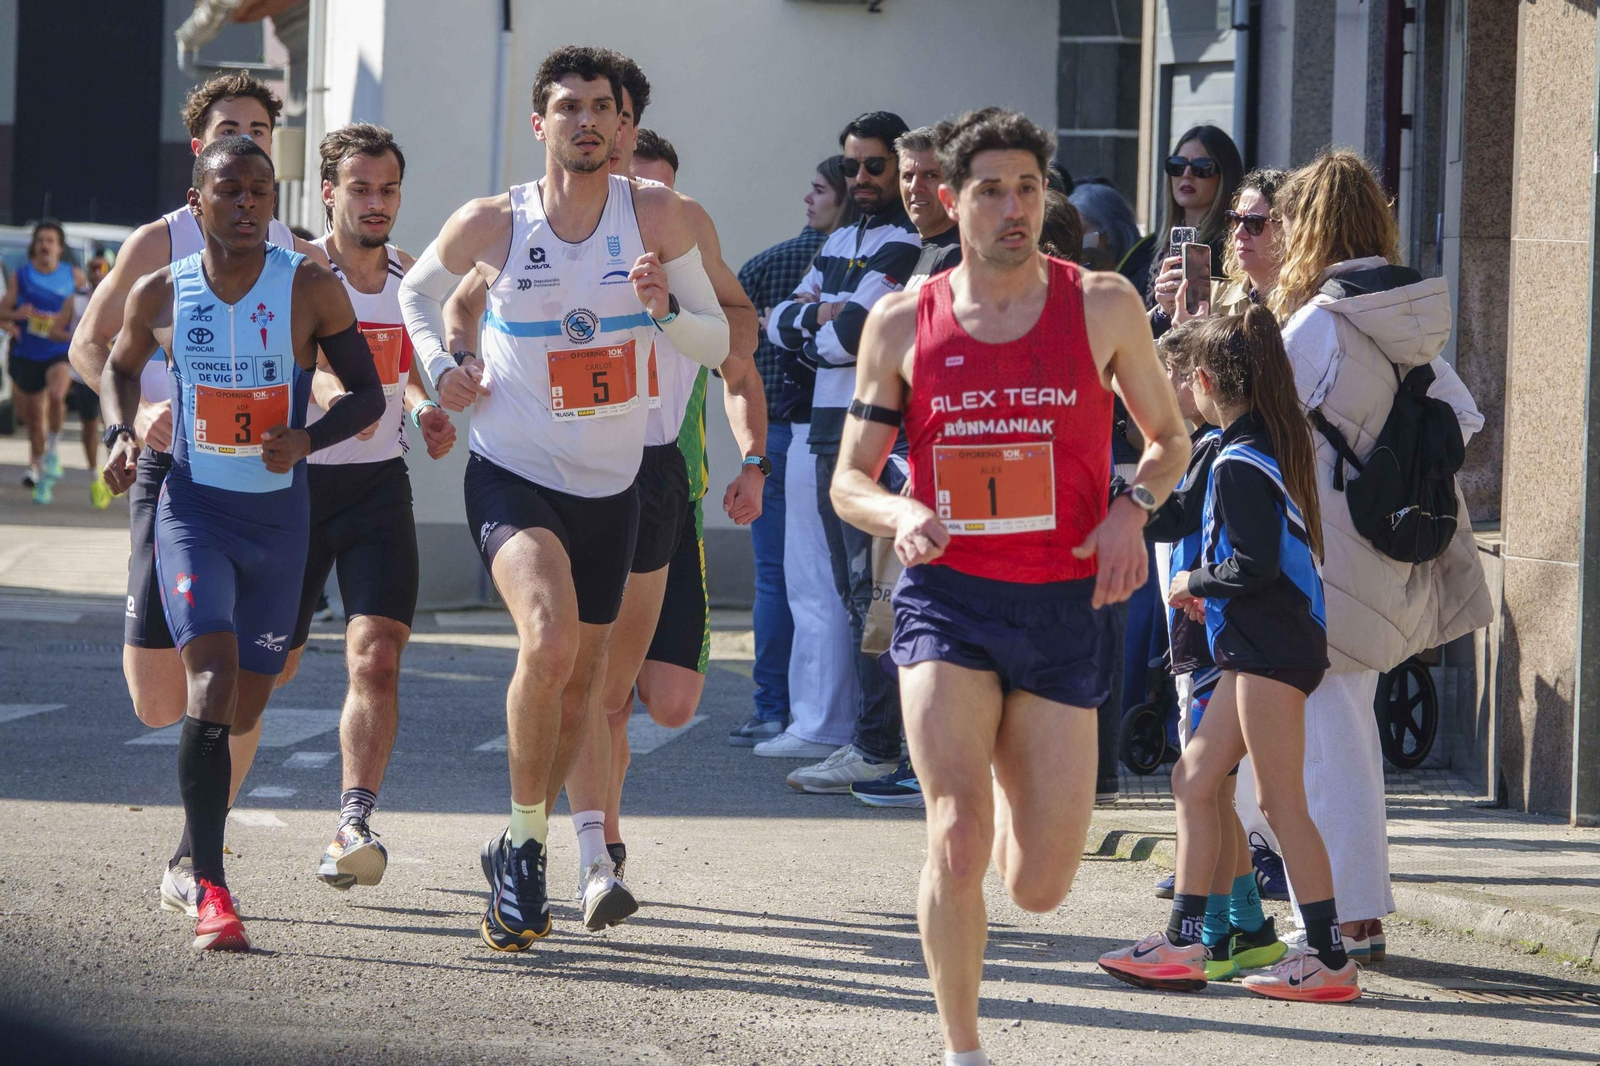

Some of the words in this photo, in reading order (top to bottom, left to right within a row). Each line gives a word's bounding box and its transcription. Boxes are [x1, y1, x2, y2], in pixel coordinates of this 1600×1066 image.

[189, 314, 213, 323] ZICO
[185, 345, 215, 353] NIPOCAR
[191, 361, 249, 372] CONCELLO
[585, 362, 613, 371] CARLOS
[198, 373, 212, 382] DE
[213, 373, 243, 383] VIGO
[592, 371, 609, 404] 5
[930, 390, 997, 413] ALEX
[1003, 387, 1078, 406] TEAM
[235, 412, 251, 444] 3
[980, 466, 1003, 475] ALEX
[987, 477, 997, 516] 1
[254, 638, 283, 652] ZICO
